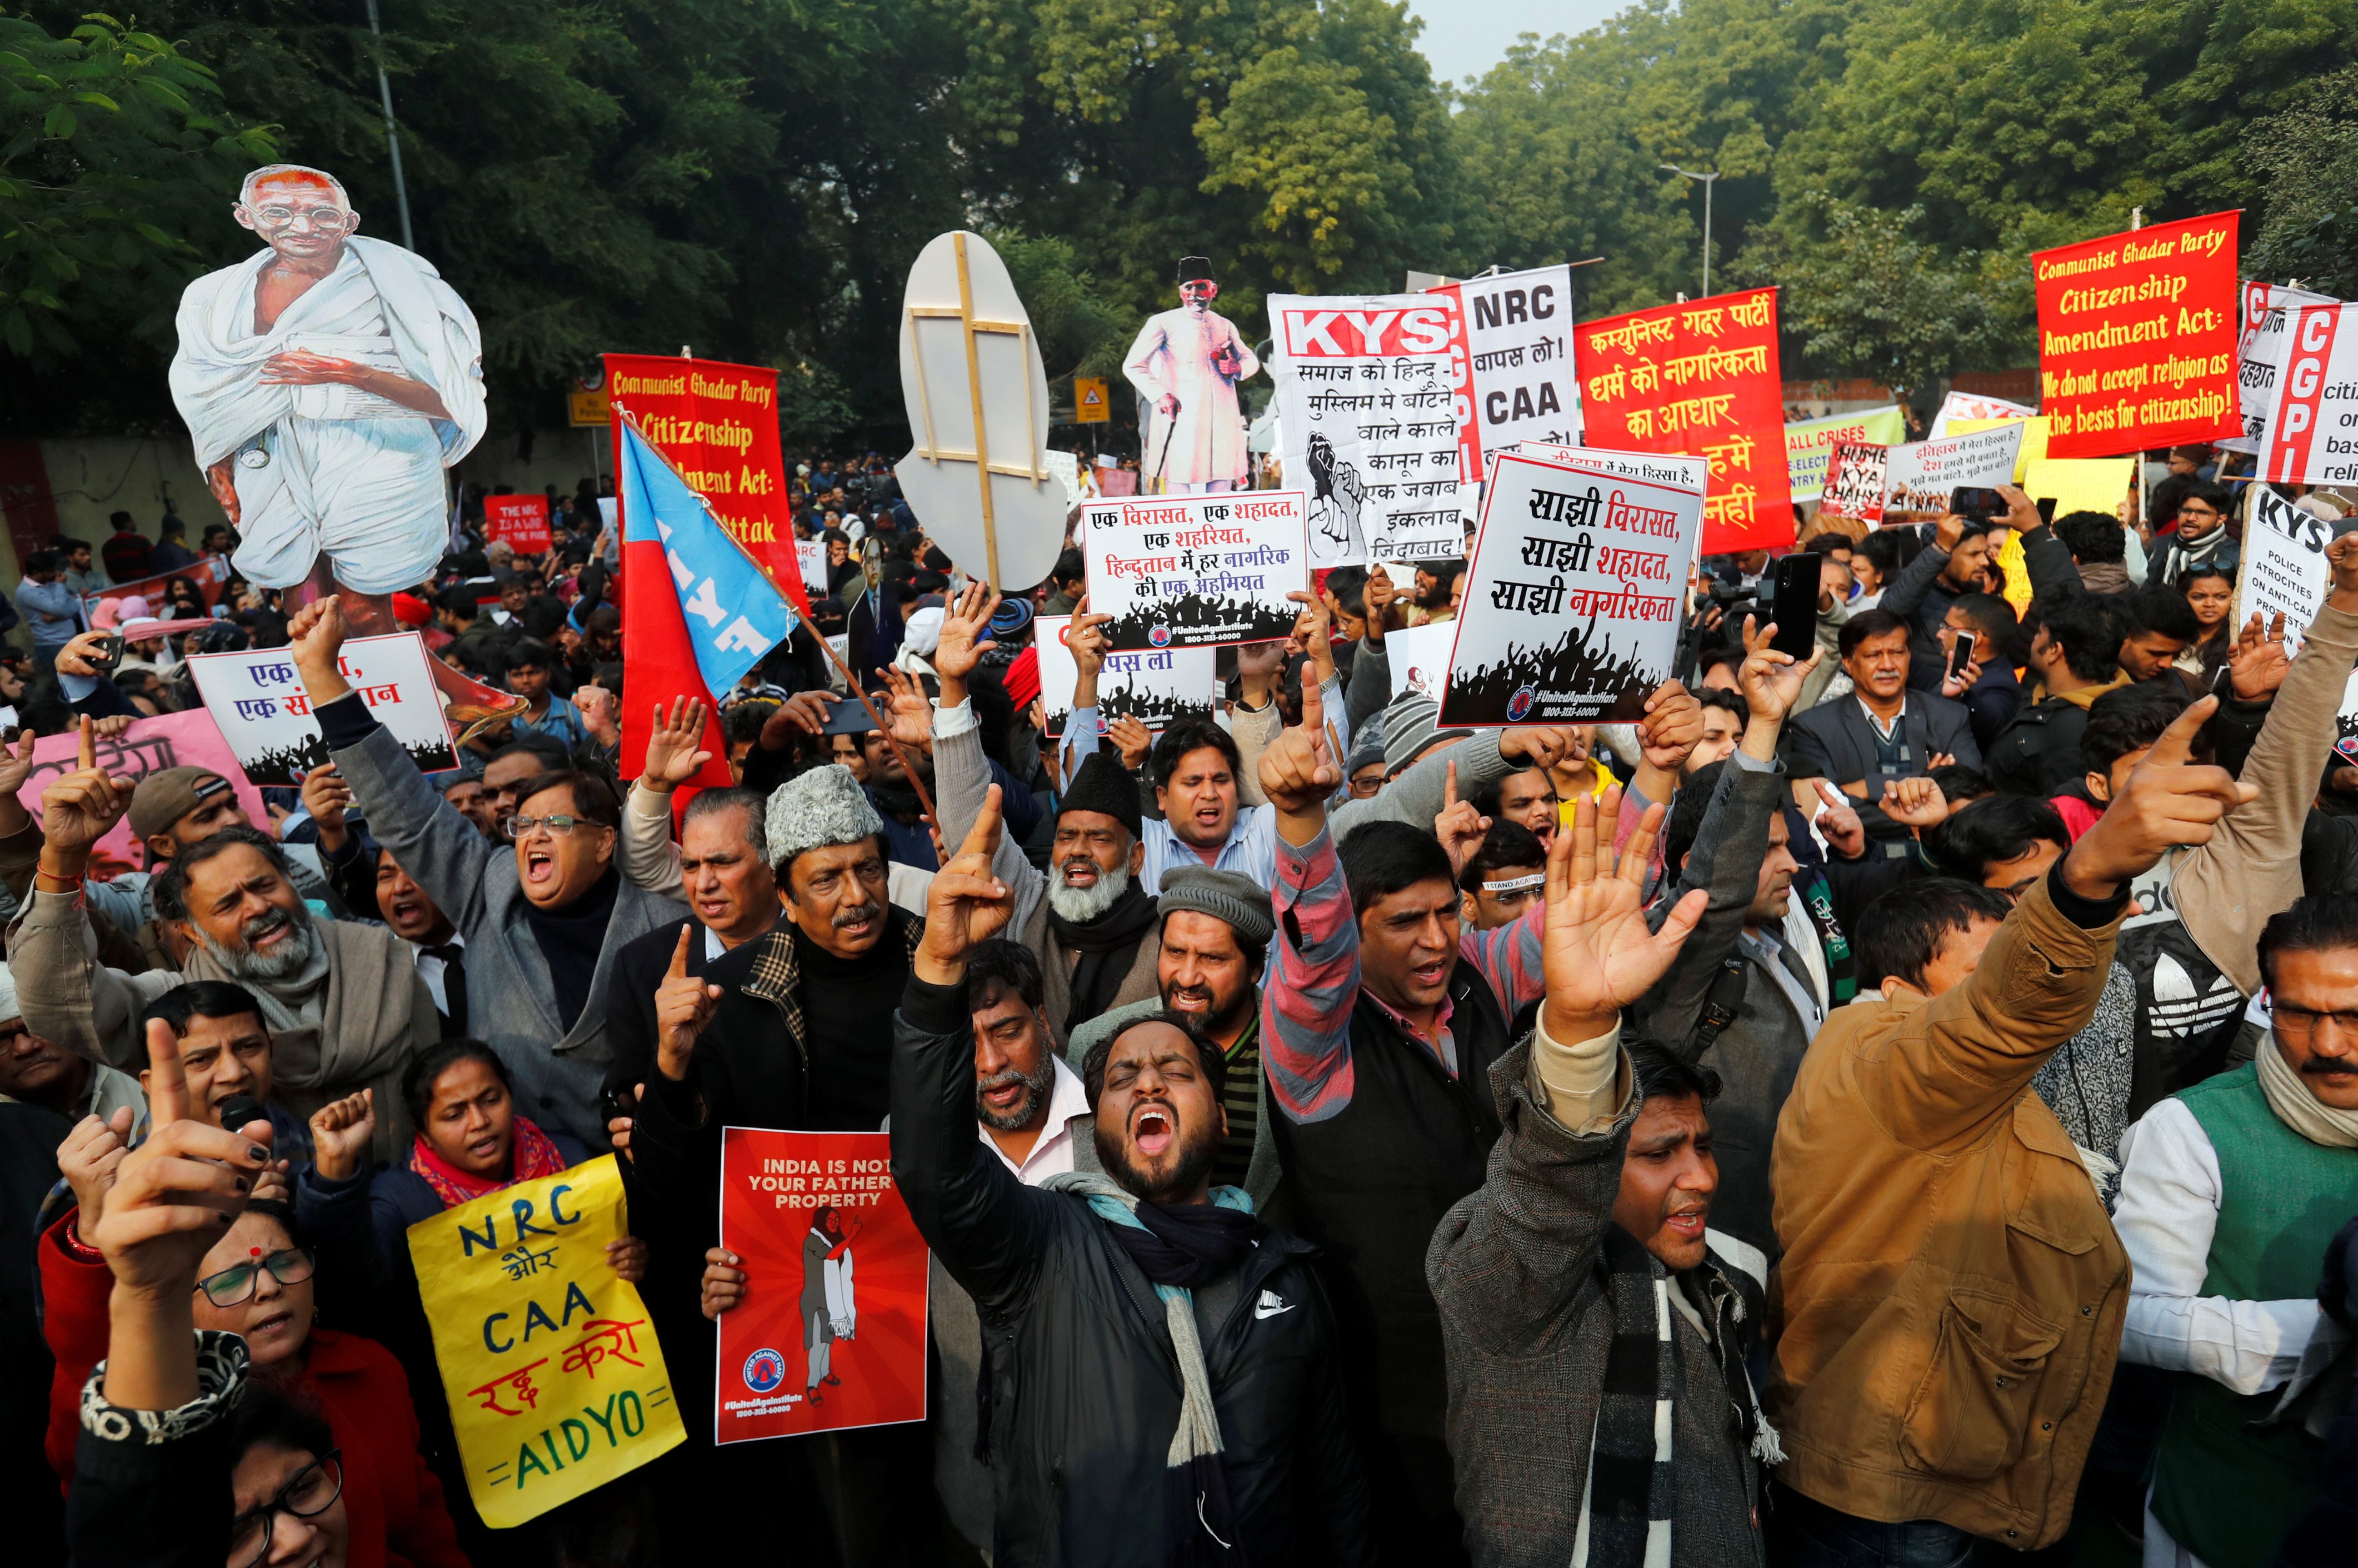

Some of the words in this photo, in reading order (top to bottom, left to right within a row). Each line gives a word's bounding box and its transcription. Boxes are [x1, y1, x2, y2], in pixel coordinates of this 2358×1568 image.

[2039, 252, 2117, 281] Communist
[2122, 239, 2176, 265] Ghadar
[2181, 228, 2227, 258] Party
[1473, 285, 1555, 330] NRC
[2060, 273, 2187, 315] Citizenship
[1290, 308, 1450, 354] KYS
[1589, 317, 1676, 356] कम्युनिस्ट
[1729, 292, 1770, 328] पार्टी
[2045, 313, 2169, 356] Amendment
[2176, 307, 2223, 336] Act:
[1297, 364, 1353, 382] समाज
[1360, 359, 1386, 381] को
[1473, 347, 1526, 373] वापस
[1589, 364, 1627, 403] धर्म
[1630, 356, 1660, 395] को
[1664, 344, 1767, 386] नागरिकता
[2042, 371, 2057, 399] We
[2102, 362, 2149, 392] accept
[2153, 353, 2207, 390] religion
[2210, 353, 2229, 376] as
[613, 371, 686, 396] Communist
[691, 372, 737, 400] Ghadar
[741, 379, 771, 410] Party
[1486, 382, 1561, 425] CAA
[2281, 311, 2331, 483] CGPI
[1308, 389, 1373, 421] मुस्लिम
[1626, 410, 1653, 440] का
[1658, 393, 1739, 435] आधार
[2048, 408, 2072, 437] the
[2076, 404, 2115, 433] besis
[2116, 398, 2136, 428] for
[2140, 383, 2232, 426] citizenship!
[642, 412, 753, 456] Citizenship
[1357, 418, 1401, 441] वाले
[1407, 415, 1457, 438] काले
[1790, 433, 1812, 451] ALL
[1817, 425, 1865, 446] CRISES
[1367, 451, 1423, 477] कानून
[1430, 450, 1458, 466] का
[1916, 443, 1958, 460] इतिहास
[1841, 467, 1877, 487] KYA
[1923, 460, 1942, 472] देश
[739, 465, 773, 496] Act:
[1363, 483, 1395, 505] एक
[1402, 480, 1459, 499] जवाब
[499, 506, 521, 517] THE
[1091, 512, 1117, 528] एक
[1123, 503, 1193, 526] विरासत,
[1204, 505, 1230, 522] एक
[1235, 501, 1298, 521] शहादत,
[1387, 509, 1461, 533] इंकलाब
[1529, 487, 1602, 527] साझी
[1604, 490, 1680, 543] विरासत,
[2258, 491, 2327, 553] KYS
[1144, 532, 1170, 550] एक
[1176, 524, 1251, 549] शहरियत,
[1181, 550, 1194, 571] में
[1200, 553, 1220, 573] हर
[1224, 545, 1290, 568] नागरिक
[1521, 532, 1594, 572] साझी
[1596, 546, 1671, 585] शहादत,
[2268, 550, 2303, 576] POLICE
[1135, 576, 1157, 598] की
[1163, 580, 1188, 596] एक
[2256, 561, 2312, 600] ATROCITIES
[1491, 575, 1566, 616] साझी
[1570, 582, 1676, 622] नागरिकता
[2252, 577, 2265, 592] ON
[2268, 587, 2312, 619] ANTI-CAA
[1172, 622, 1253, 635] #UnitedAgainstHate
[1185, 632, 1241, 643] 1800-3133-60000
[2265, 622, 2293, 646] DN
[1147, 650, 1173, 670] लो
[247, 663, 293, 687] एक
[233, 698, 277, 721] एक
[1535, 690, 1617, 706] #UnitedAgainstHate
[1542, 707, 1600, 717] 1800-3133-60000
[1515, 876, 1542, 886] AGAINST
[764, 1158, 825, 1175] INDIA
[828, 1158, 846, 1174] IS
[748, 1176, 805, 1191] YOUR
[776, 1192, 881, 1209] PROPERTY
[458, 1184, 580, 1257] NRC
[502, 1246, 559, 1281] और
[1259, 1289, 1283, 1310] NIKE
[483, 1281, 596, 1354] CAA
[562, 1319, 646, 1380] करो
[746, 1358, 756, 1383] UNITED
[755, 1351, 780, 1362] AGAINST
[775, 1361, 783, 1380] HATE
[725, 1394, 802, 1410] #UnitedAgainstHate
[736, 1405, 791, 1418] 1800-3133-60000
